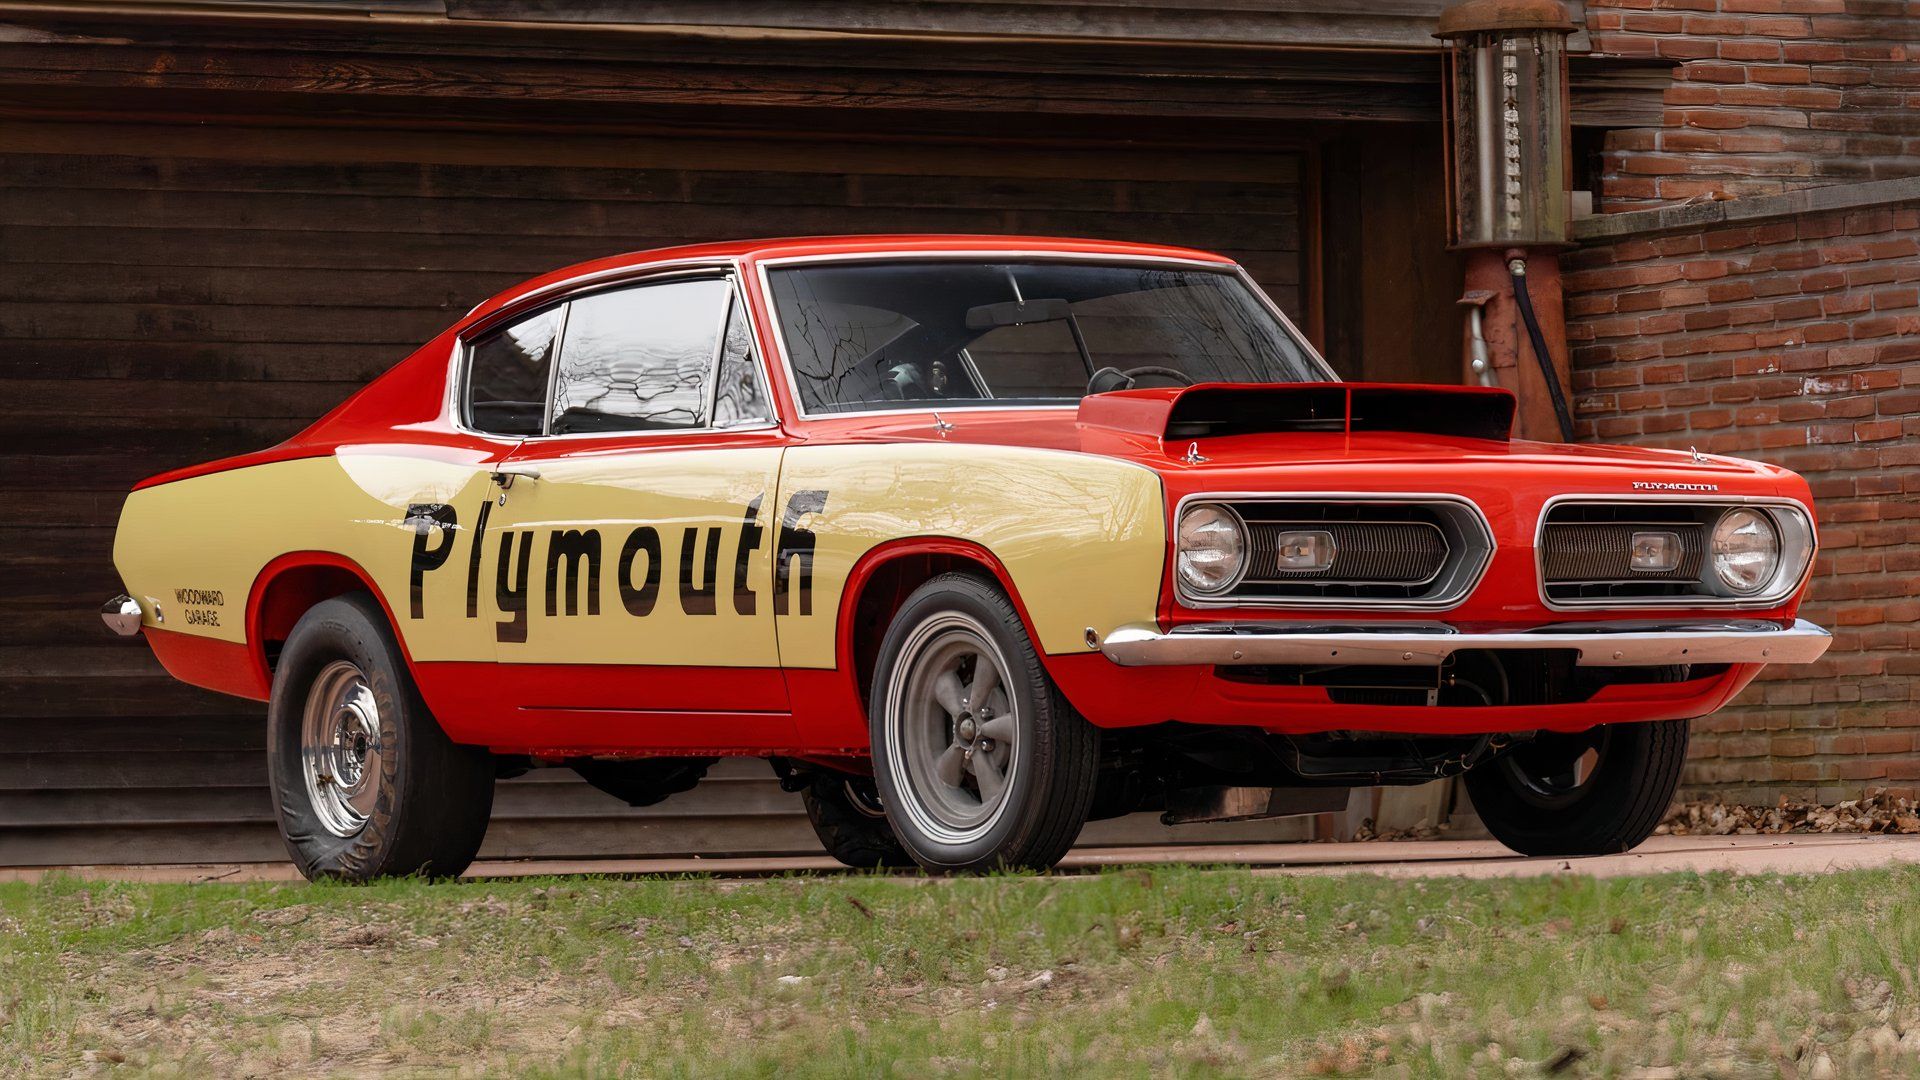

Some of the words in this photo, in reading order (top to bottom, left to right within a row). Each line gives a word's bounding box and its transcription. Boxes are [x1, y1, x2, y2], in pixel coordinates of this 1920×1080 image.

[1632, 481, 1718, 491] PLYMOUTH
[403, 490, 829, 643] Plymouth
[174, 588, 225, 606] WOODWARD
[184, 609, 221, 627] GARAGE
